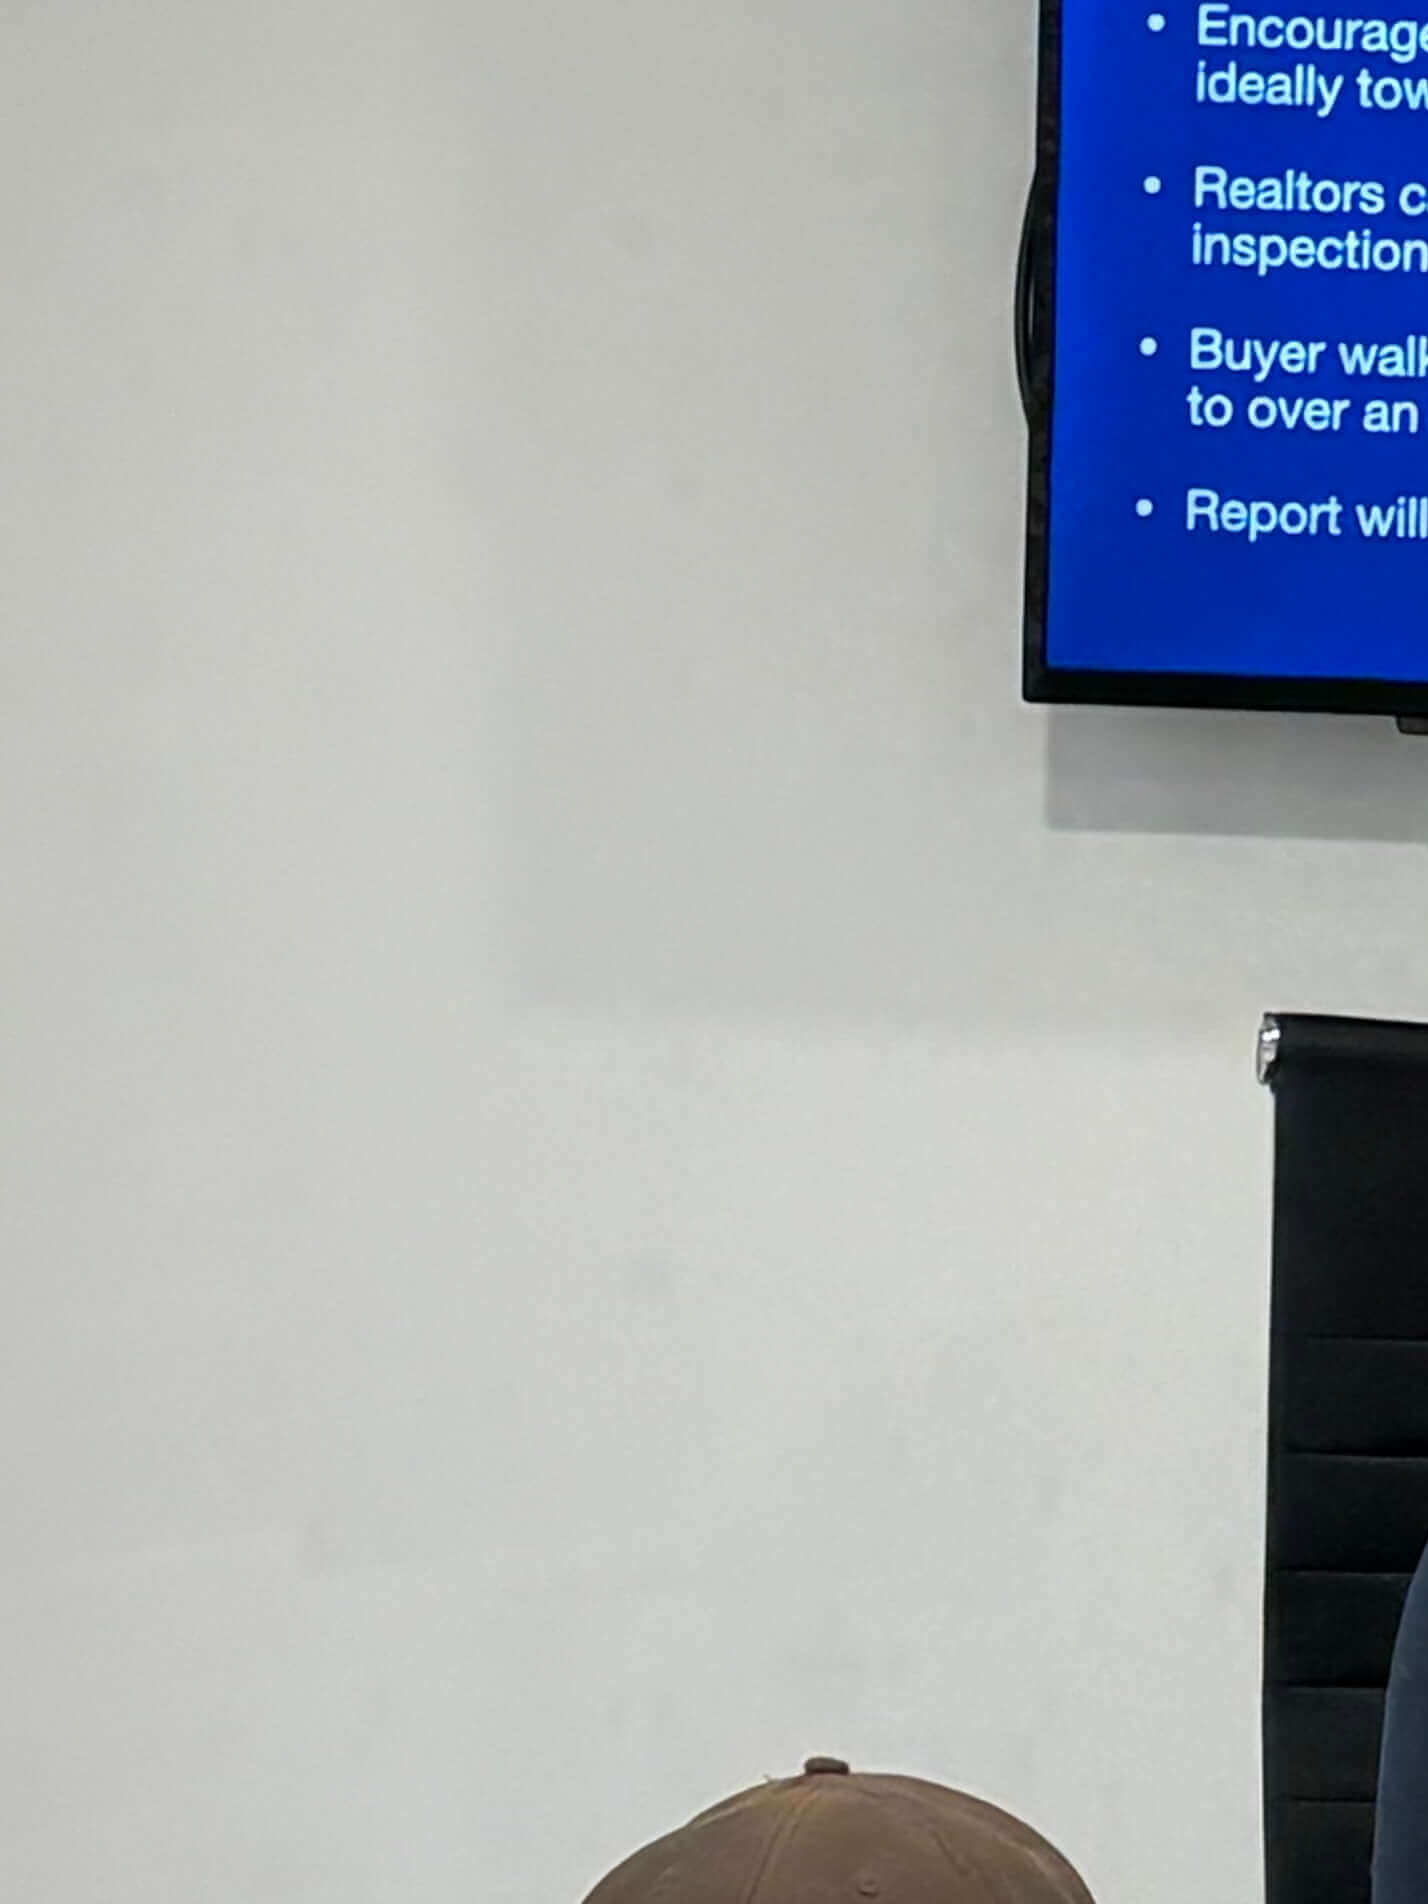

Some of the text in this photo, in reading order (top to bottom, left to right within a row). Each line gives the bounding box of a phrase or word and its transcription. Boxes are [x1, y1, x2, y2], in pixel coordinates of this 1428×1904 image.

[1197, 60, 1344, 117] ideally
[1195, 166, 1385, 214] Realtors
[1191, 327, 1326, 382] Buyer
[1186, 386, 1233, 427] to
[1248, 396, 1351, 430] over
[1363, 400, 1418, 433] an
[1187, 488, 1342, 542] Report
[1356, 496, 1428, 538] will
